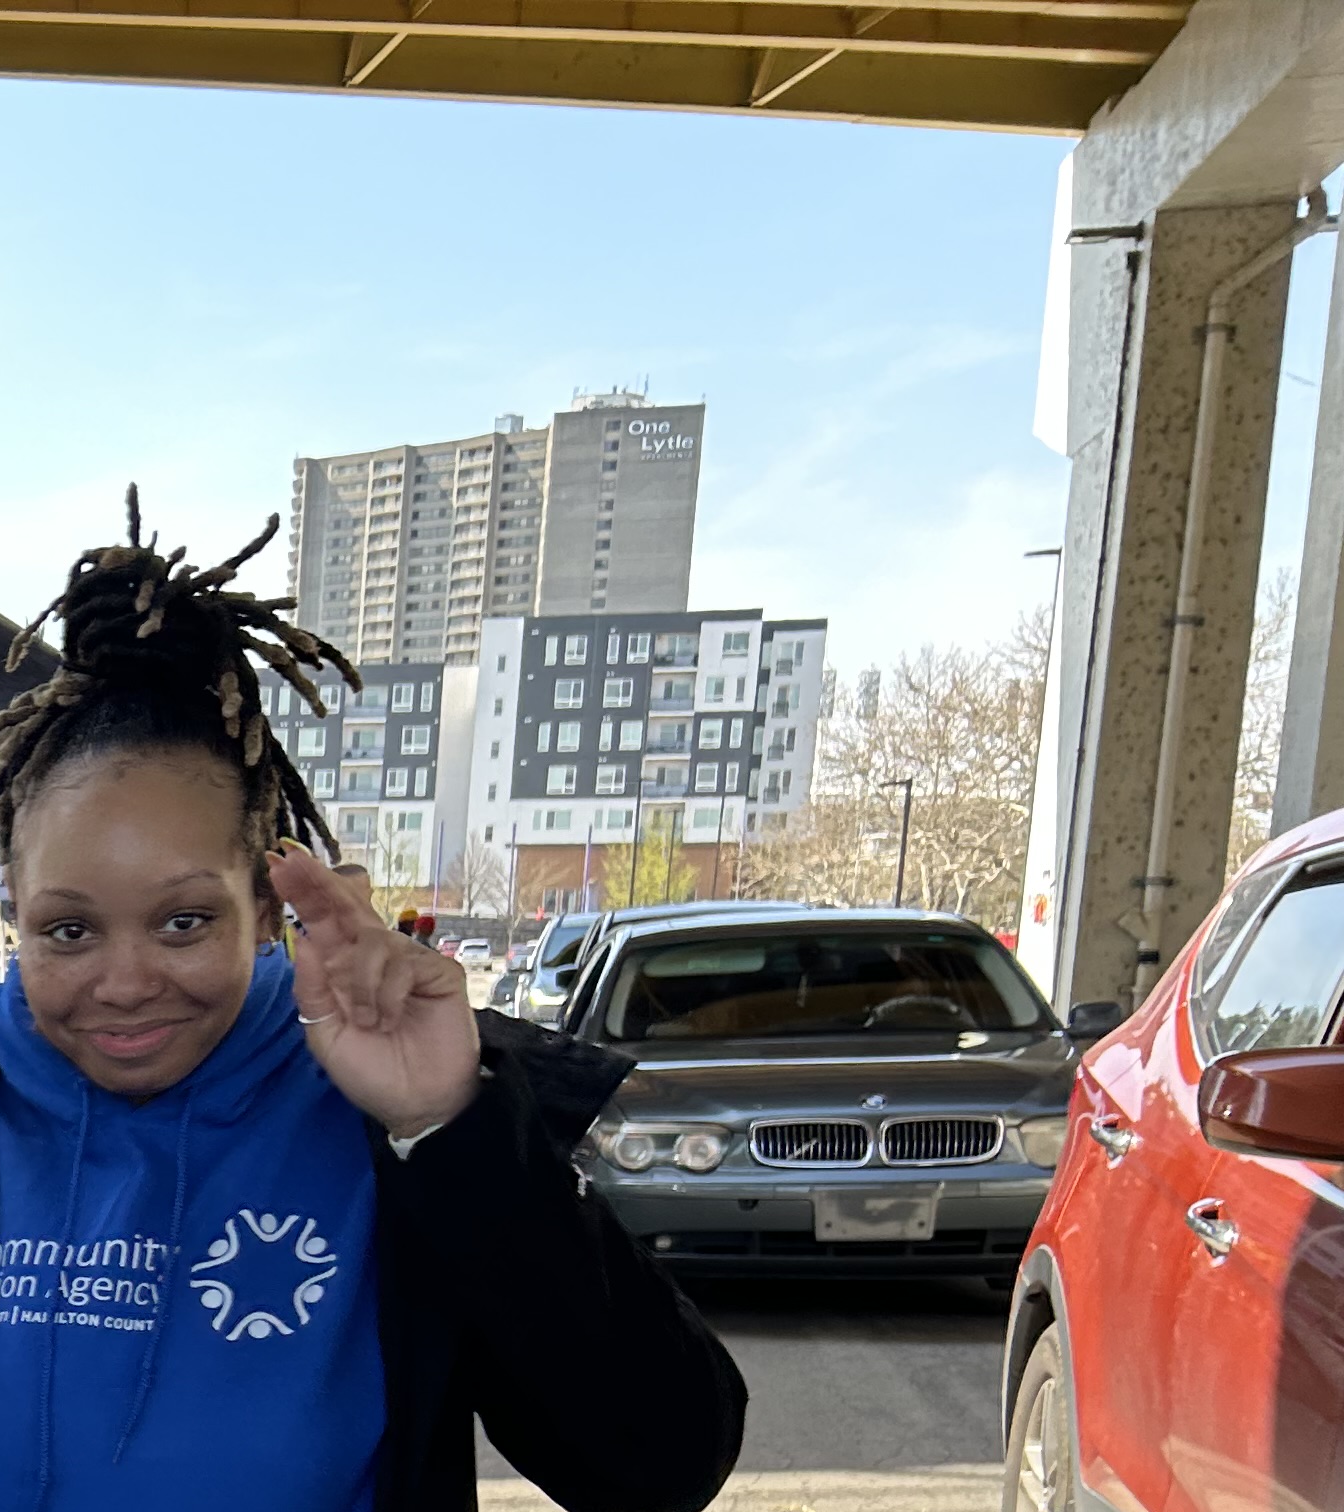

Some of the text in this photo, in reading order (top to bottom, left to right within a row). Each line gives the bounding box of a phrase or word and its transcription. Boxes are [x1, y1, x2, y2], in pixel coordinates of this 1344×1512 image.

[628, 420, 670, 435] One
[641, 434, 694, 453] Lytle
[103, 1315, 155, 1332] COUNT
